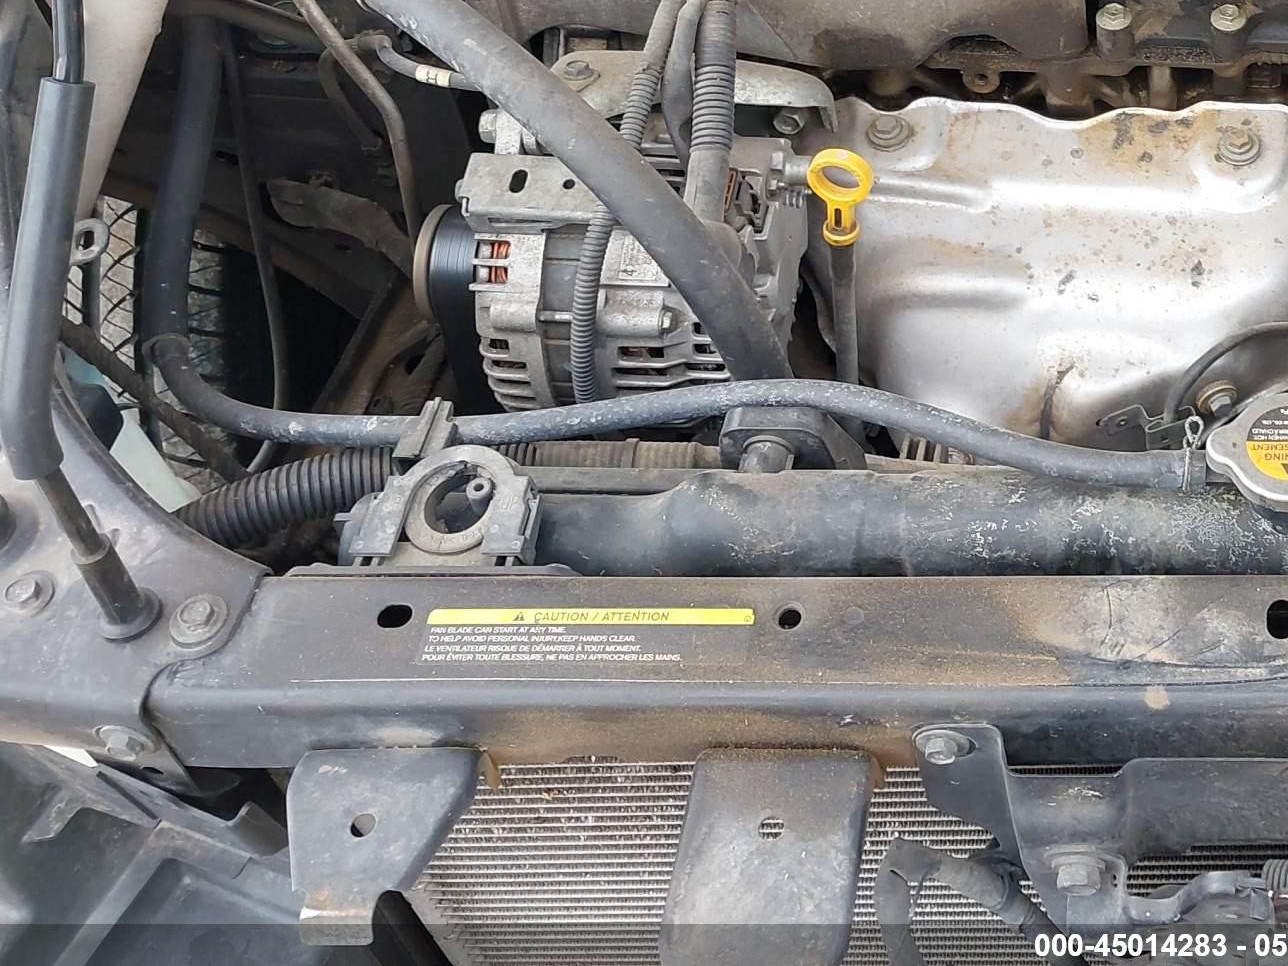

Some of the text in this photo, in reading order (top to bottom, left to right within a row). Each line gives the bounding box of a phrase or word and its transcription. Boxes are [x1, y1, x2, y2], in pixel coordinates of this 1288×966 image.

[534, 611, 589, 623] CAUTION
[601, 610, 670, 622] ATTENTION
[430, 626, 447, 634] FAN
[447, 626, 474, 634] BLADE
[474, 626, 492, 634] CAN
[493, 626, 518, 634] START
[529, 626, 547, 634] ANY
[428, 635, 440, 643] TO
[440, 635, 461, 643] HELP
[461, 635, 487, 643] AVOID
[487, 635, 529, 643] PERSONAL
[579, 635, 607, 643] HANDS
[436, 644, 487, 652] VENTILATEUR
[487, 644, 518, 652] RISQUE
[518, 644, 531, 652] DE
[531, 642, 576, 652] DÉMARRER
[583, 644, 604, 652] TOUT
[422, 653, 445, 661] POUR
[445, 652, 474, 661] ÉVITER
[558, 653, 575, 661] PAS
[587, 653, 638, 661] APPROCHER
[638, 653, 654, 661] LES
